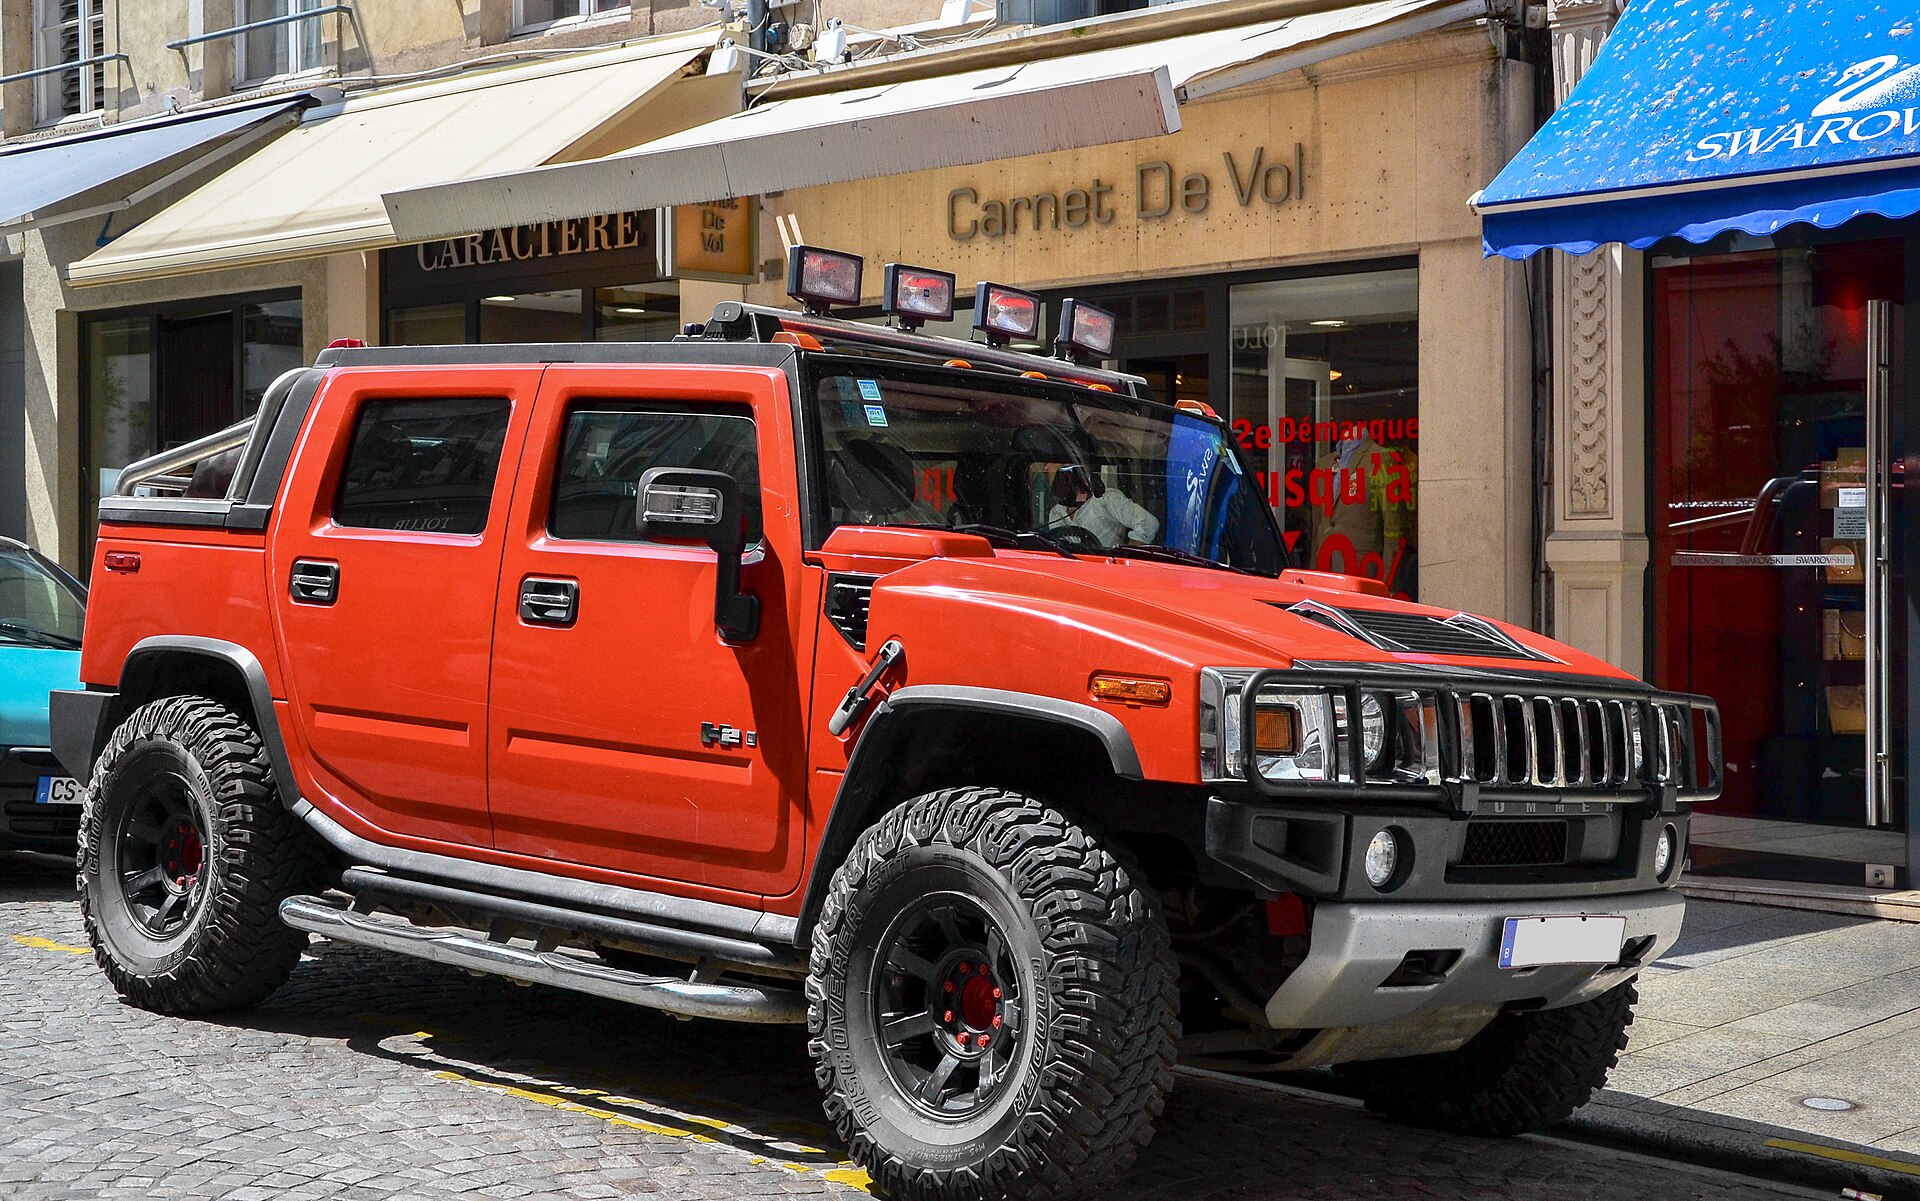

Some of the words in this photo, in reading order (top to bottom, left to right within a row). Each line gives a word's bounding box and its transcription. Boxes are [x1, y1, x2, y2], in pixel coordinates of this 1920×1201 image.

[947, 178, 1114, 241] Carnet
[1136, 160, 1209, 219] De
[1222, 142, 1303, 207] Vol
[703, 209, 726, 231] De
[701, 232, 724, 253] Vol
[1232, 418, 1272, 449] 2e
[1278, 415, 1418, 446] Démarque
[1256, 451, 1412, 517] usqu'à
[1677, 556, 1724, 565] SWAROVSKI
[1735, 556, 1784, 565] SWAROVSKI
[1795, 556, 1846, 565] SWAROVSKI
[701, 720, 742, 746] H2
[1493, 801, 1614, 814] UMMER
[1504, 947, 1510, 959] B
[828, 903, 882, 1127] DISCOVERER
[1014, 957, 1048, 1118] COOPER
